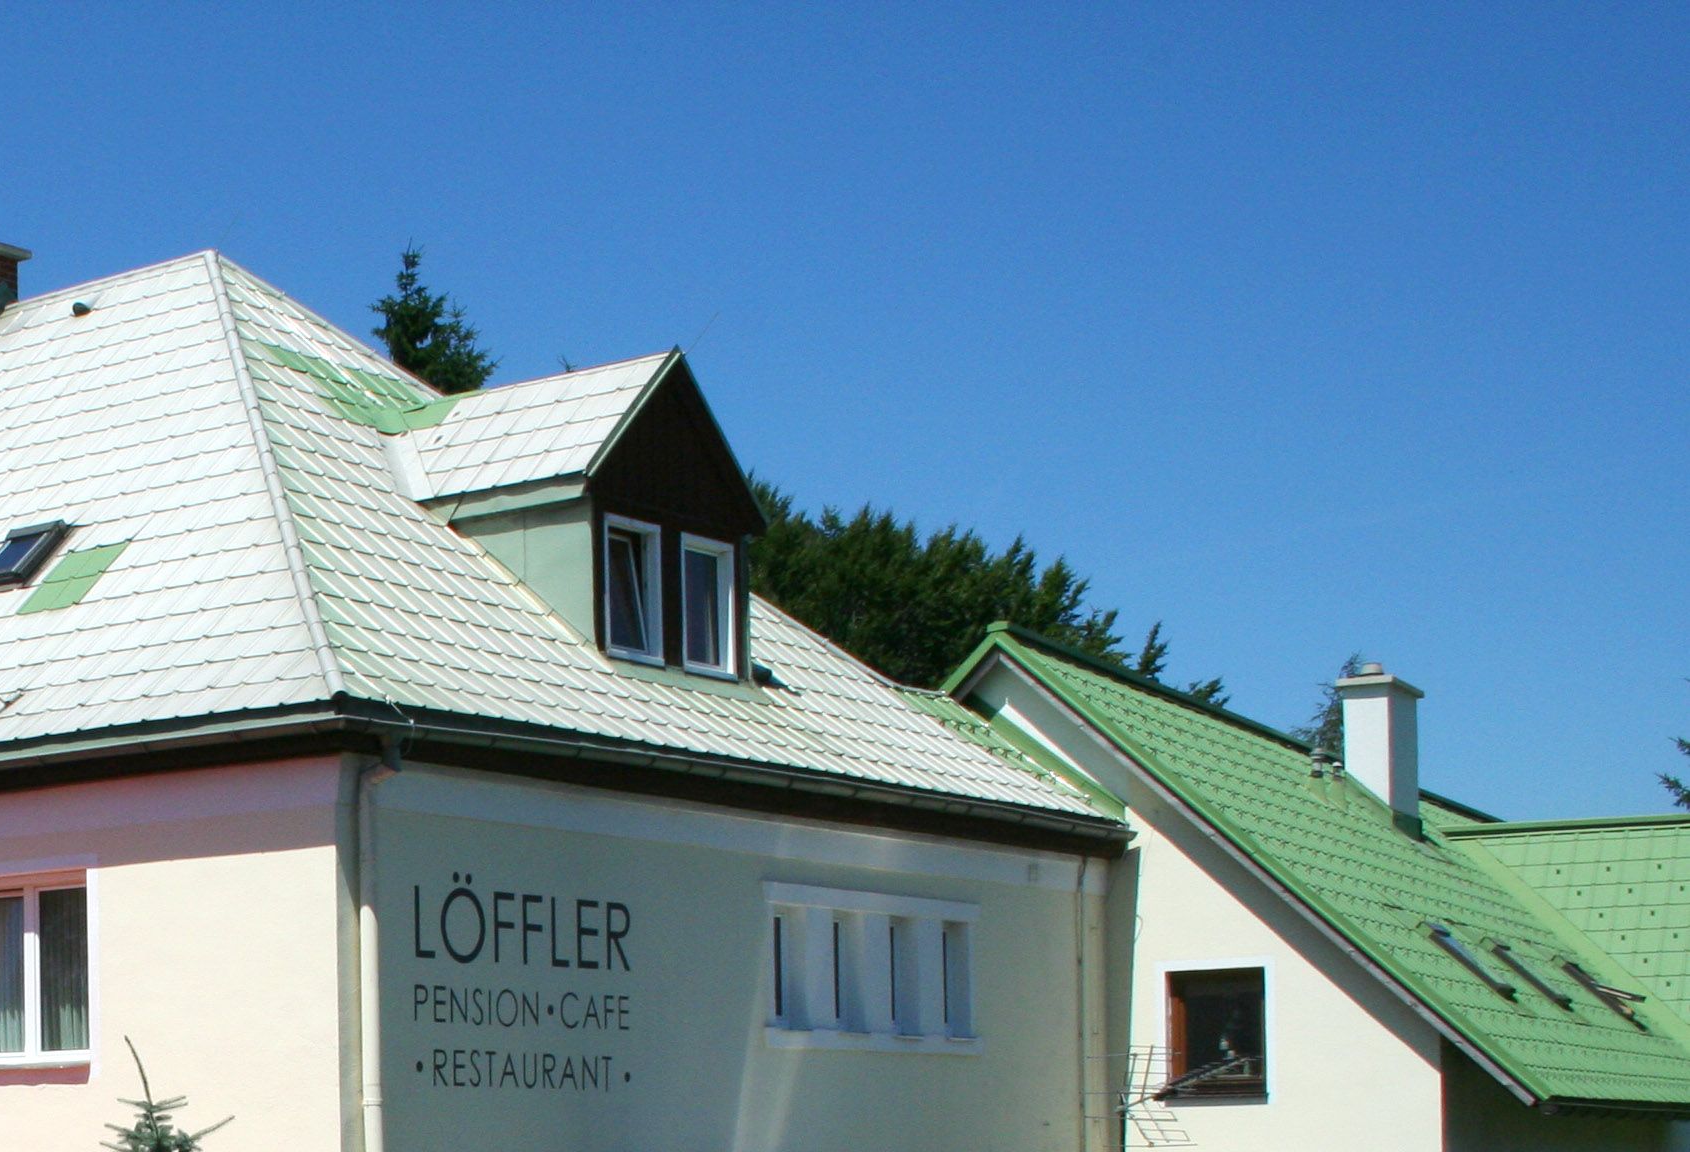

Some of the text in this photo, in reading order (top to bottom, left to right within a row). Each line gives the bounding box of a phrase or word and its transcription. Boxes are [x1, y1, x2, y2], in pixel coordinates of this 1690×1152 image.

[413, 871, 631, 972] LÖFFLER
[413, 983, 631, 1031] PENSION CAFE
[431, 1048, 613, 1093] RESTAURANT
